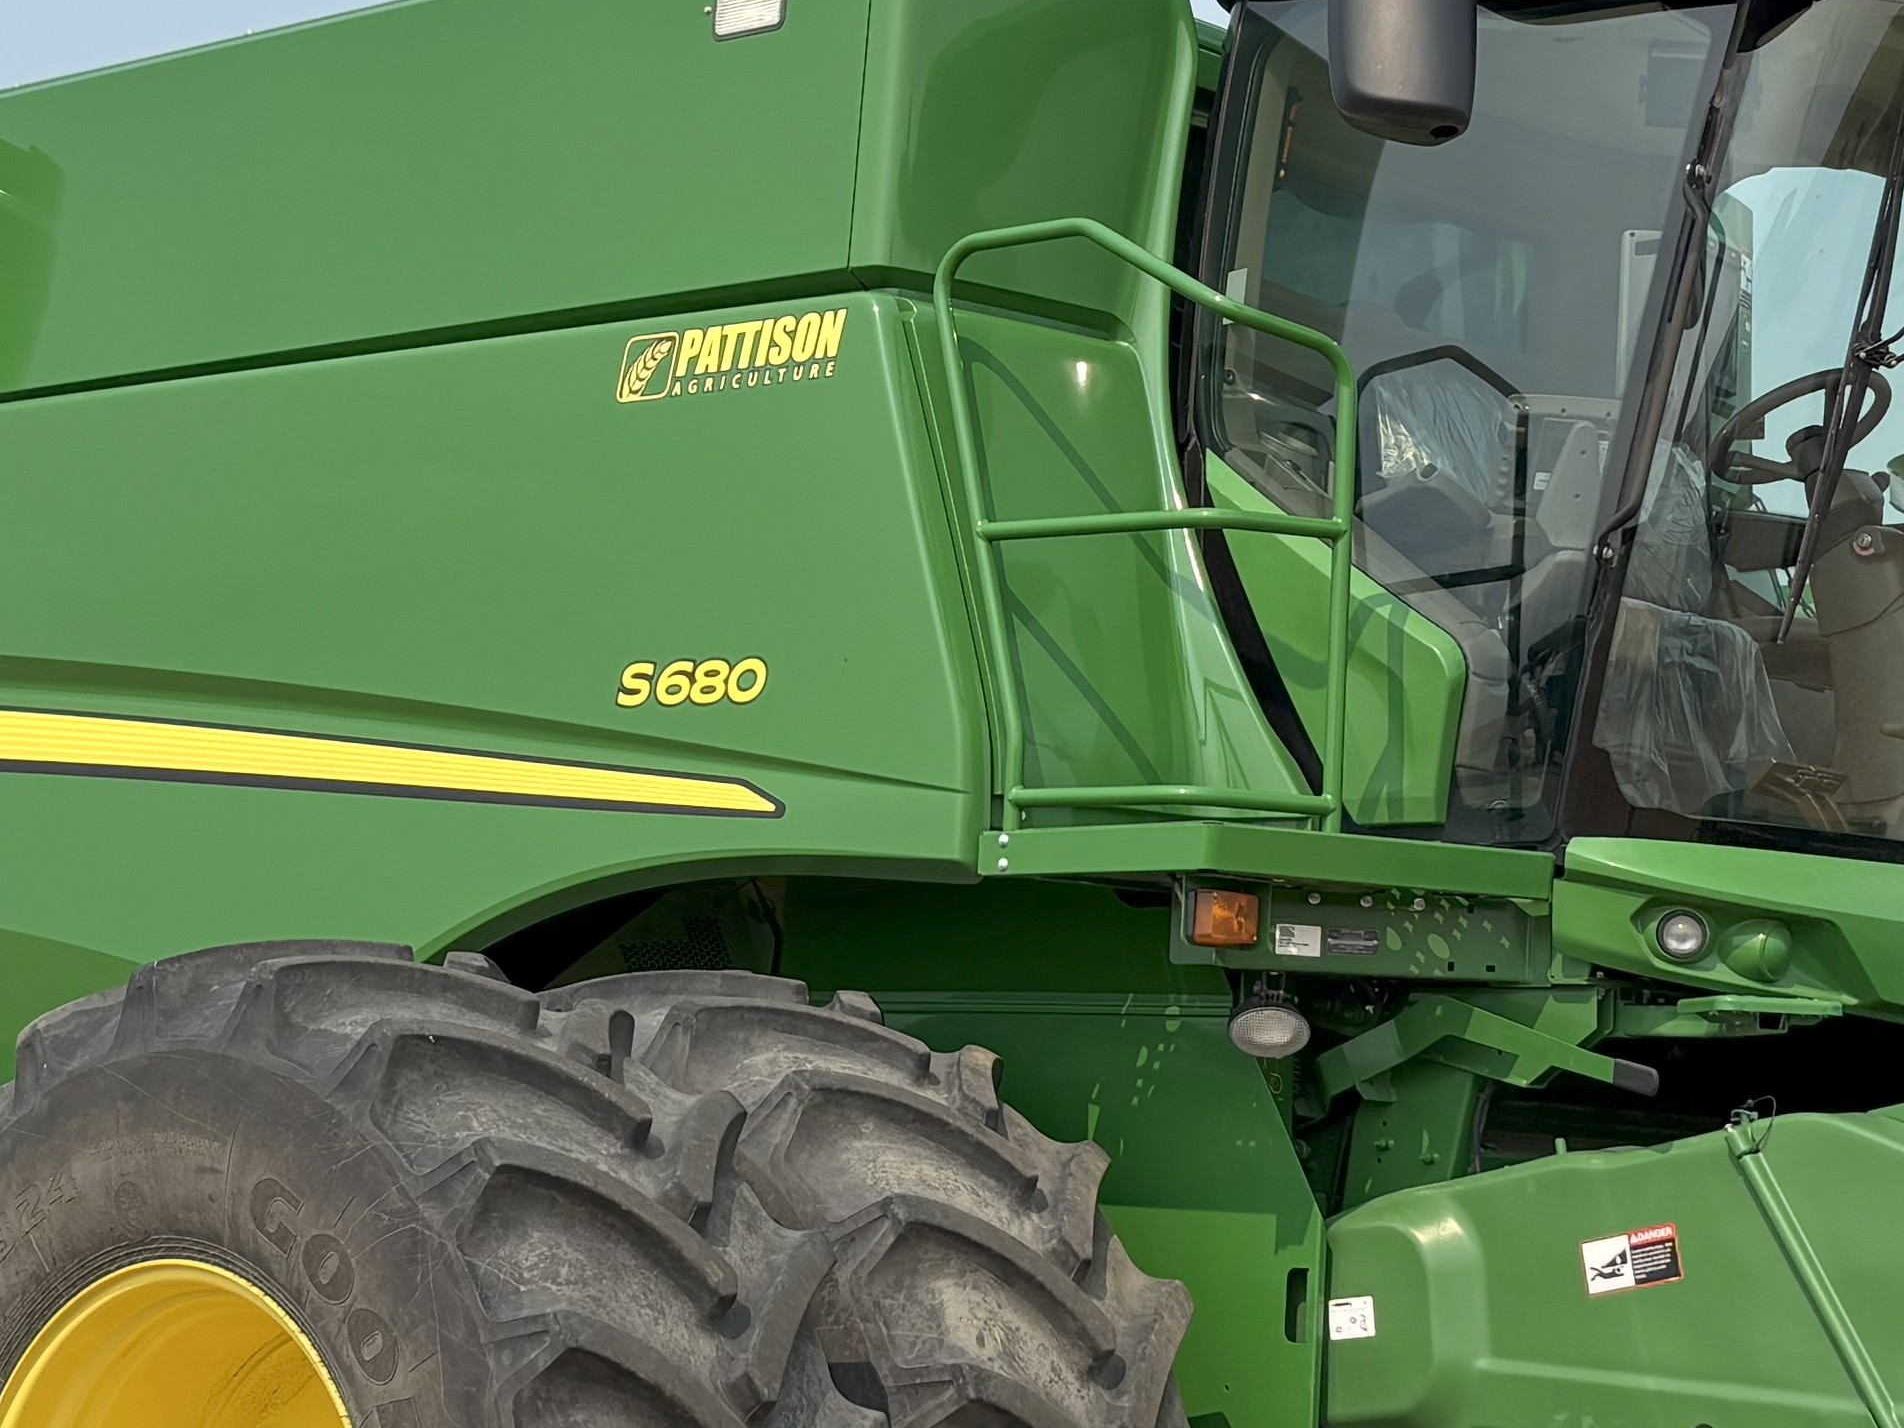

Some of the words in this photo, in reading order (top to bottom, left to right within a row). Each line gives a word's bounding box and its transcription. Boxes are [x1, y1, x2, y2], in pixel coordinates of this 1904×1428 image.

[674, 308, 847, 378] PATTISON
[671, 360, 836, 397] AGRICULTURE
[615, 655, 769, 709] S680
[1636, 1225, 1673, 1241] DANGER
